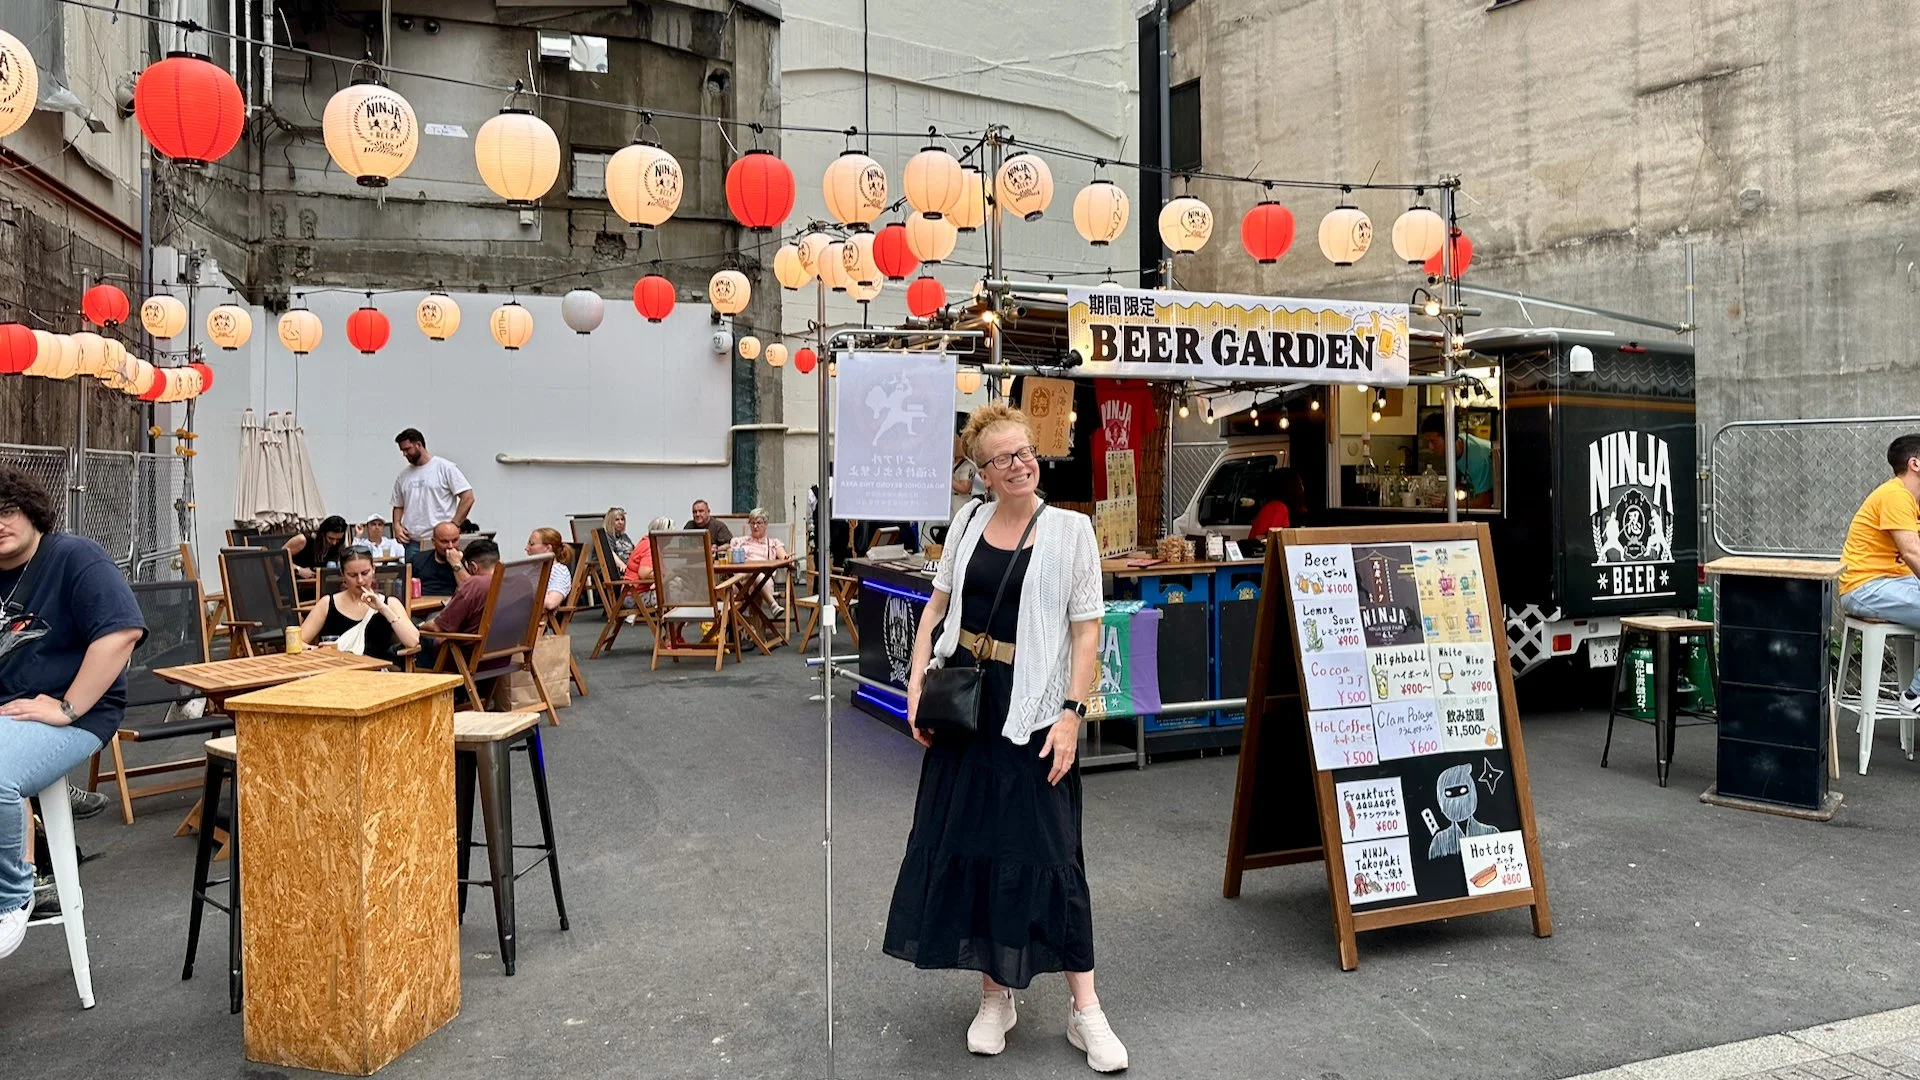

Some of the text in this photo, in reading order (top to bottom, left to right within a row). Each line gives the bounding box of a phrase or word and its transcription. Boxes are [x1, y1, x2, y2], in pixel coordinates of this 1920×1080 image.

[366, 101, 402, 122] NINJA
[1007, 163, 1030, 180] NINJA
[1089, 295, 1155, 317] 期間限定
[1089, 324, 1376, 371] BEER GARDEN
[1101, 399, 1132, 430] NINJA
[1589, 431, 1674, 516] NINJA
[1305, 552, 1337, 567] Beer
[1322, 568, 1347, 579] ビール
[1612, 565, 1655, 594] BEER
[1327, 584, 1353, 593] ¥1000
[1303, 604, 1334, 616] Lemon
[1333, 615, 1355, 625] Sour
[1362, 607, 1408, 628] NINJA
[1321, 627, 1359, 636] レモンサワー
[1337, 635, 1359, 646] ¥900
[1375, 649, 1426, 666] Highball
[1438, 648, 1462, 657] White
[1465, 656, 1484, 665] Wine
[1311, 662, 1350, 677] Cocoa
[1393, 669, 1430, 679] ハイボール
[1339, 675, 1363, 687] ココア
[1471, 681, 1492, 692] ¥900
[1338, 690, 1366, 705] ¥500
[1446, 708, 1486, 723] 飲み放題
[1338, 719, 1371, 735] Coffee
[1410, 740, 1438, 754] ¥600
[1344, 751, 1374, 765] ¥500
[1343, 787, 1395, 801] Frankfurt
[1356, 799, 1397, 810] sausage
[1357, 809, 1401, 819] フランクフルト
[1376, 820, 1398, 832] ¥600
[1362, 846, 1389, 859] NINJA
[1470, 841, 1514, 858] Hotdog
[1355, 855, 1401, 871] Takoyaki
[1374, 868, 1403, 880] たこ焼き
[1501, 873, 1522, 886] ¥800
